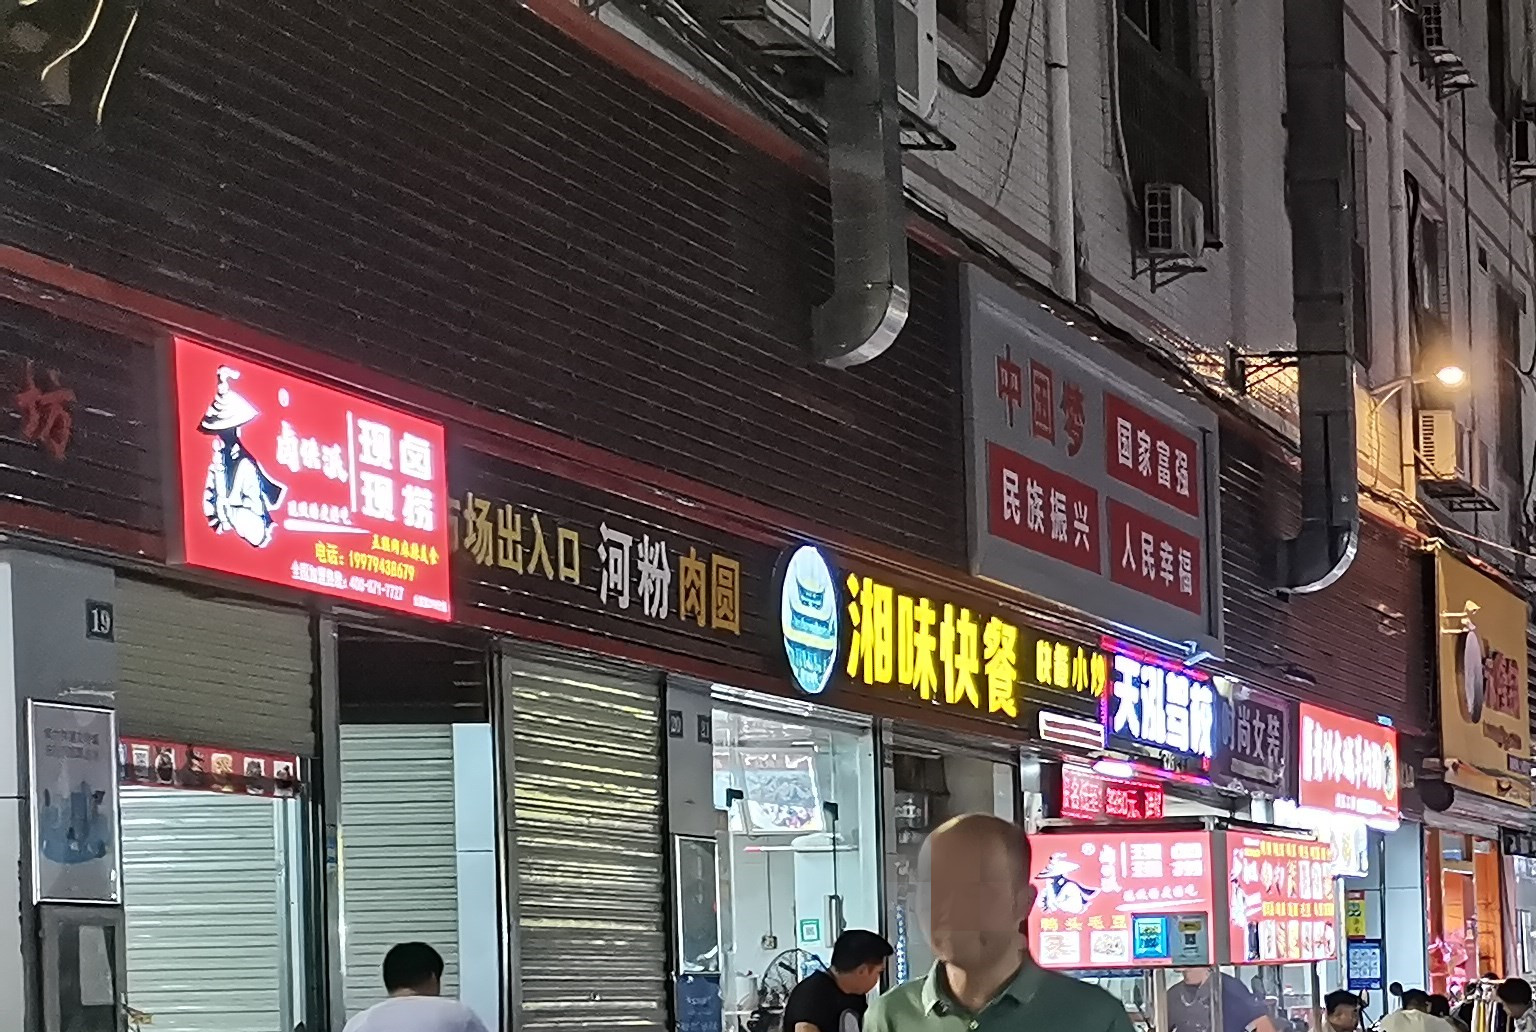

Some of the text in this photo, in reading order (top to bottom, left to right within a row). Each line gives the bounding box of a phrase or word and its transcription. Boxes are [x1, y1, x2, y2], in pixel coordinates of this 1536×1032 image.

[995, 344, 1086, 457] 中国梦
[1116, 416, 1190, 498] 国家富强
[1002, 468, 1090, 552] 民族振兴
[1122, 521, 1193, 596] 人民幸福
[90, 607, 111, 634] 19
[846, 573, 1019, 719] 湘味快餐
